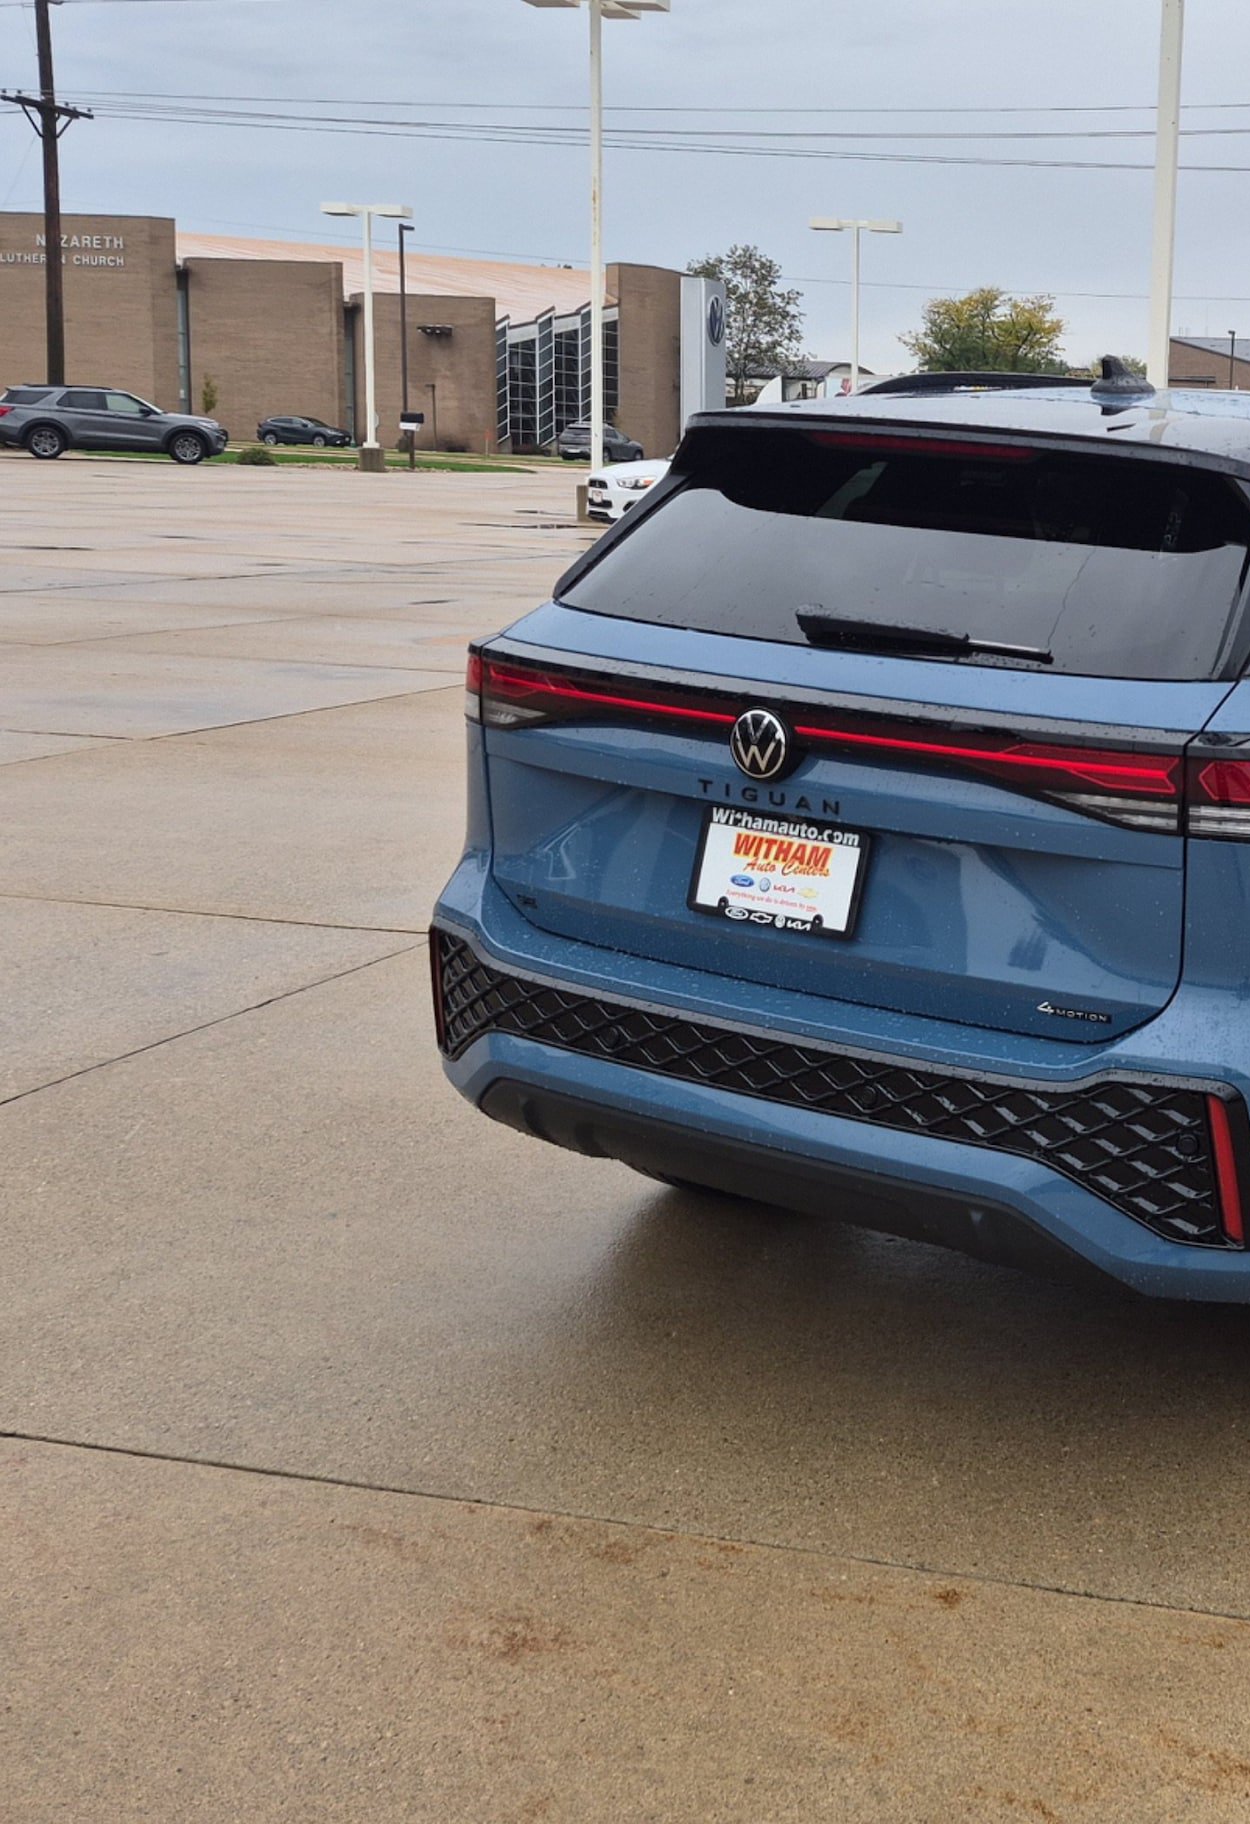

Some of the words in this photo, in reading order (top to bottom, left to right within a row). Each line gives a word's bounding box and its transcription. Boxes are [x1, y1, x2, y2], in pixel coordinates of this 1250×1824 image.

[35, 233, 124, 249] NZARETH
[73, 254, 124, 267] CHURCH
[697, 778, 841, 815] TIGUAN
[733, 833, 833, 868] WITHAM
[743, 857, 777, 873] Auto
[1036, 1001, 1108, 1022] 4MOTION
